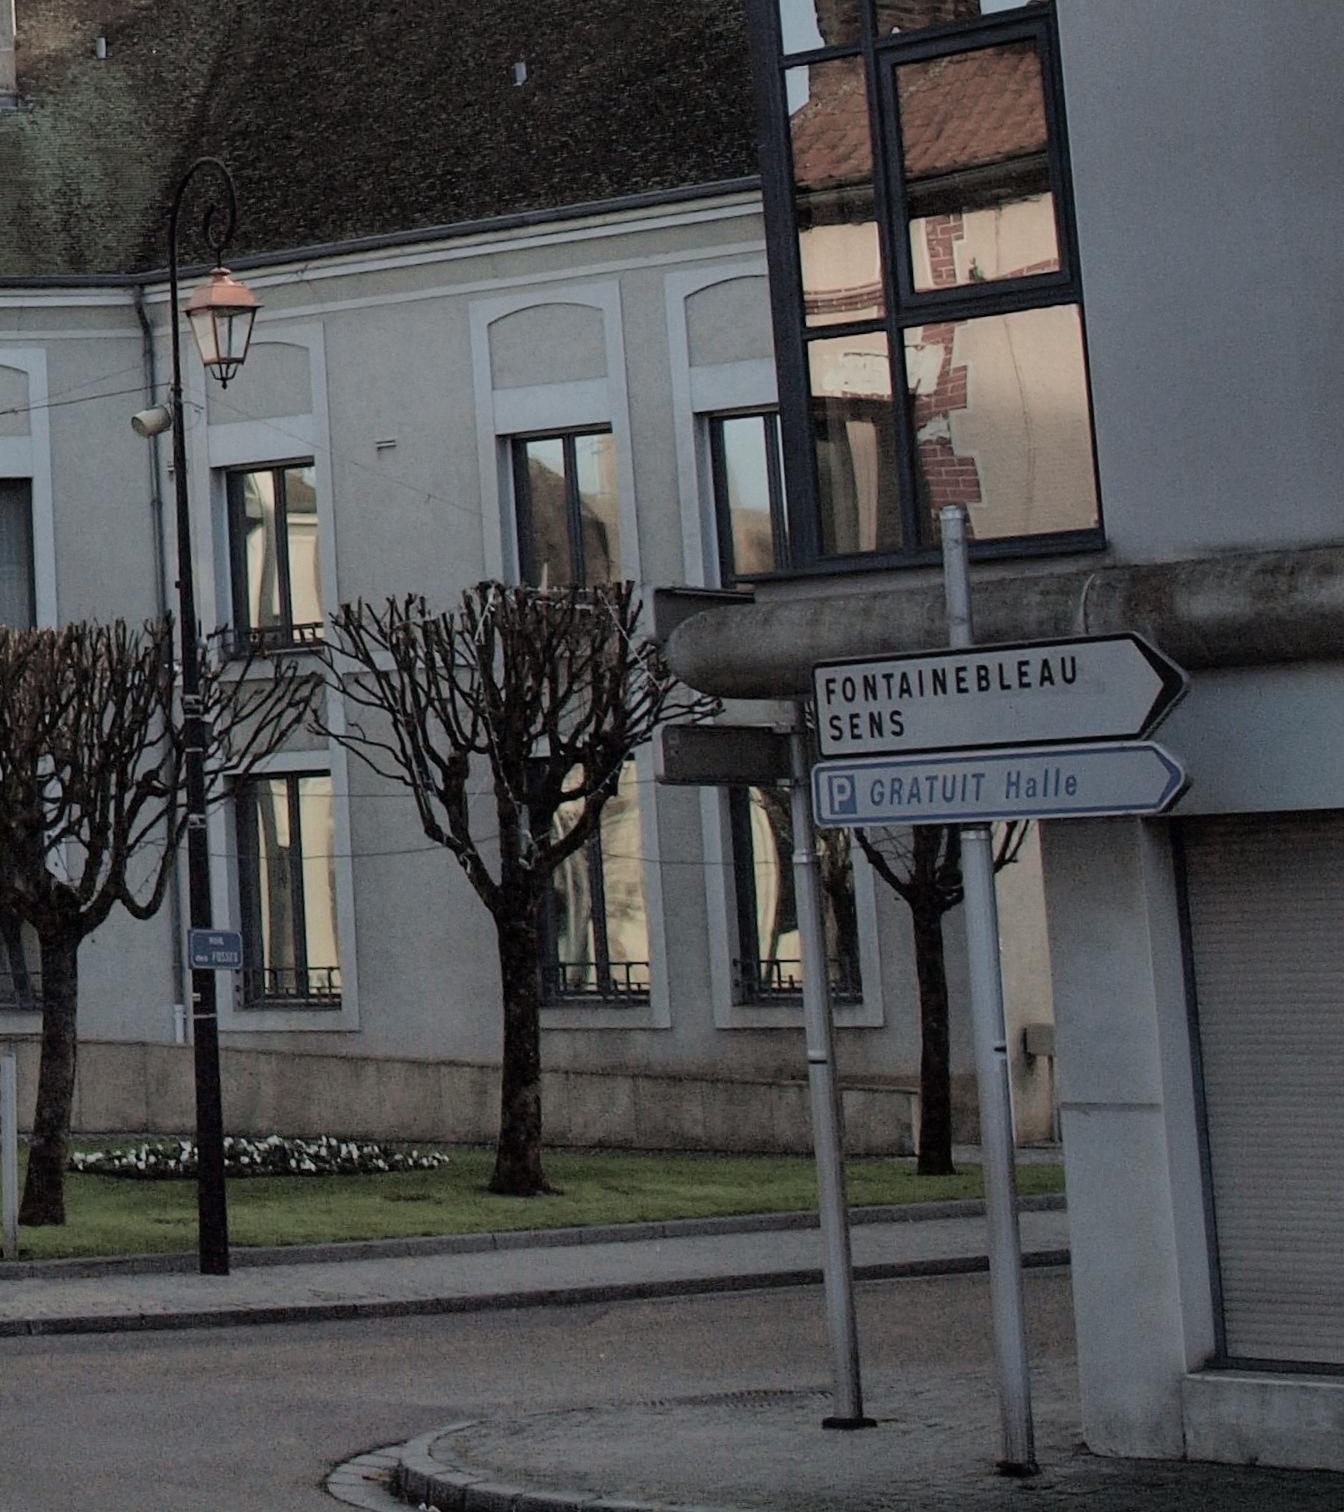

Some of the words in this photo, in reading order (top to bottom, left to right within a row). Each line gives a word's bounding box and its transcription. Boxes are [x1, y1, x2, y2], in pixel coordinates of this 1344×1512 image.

[824, 656, 1078, 705] FONTAINEBLEAU
[828, 710, 905, 742] SENS
[870, 772, 986, 807] GRATUIT
[1005, 768, 1078, 801] Halle
